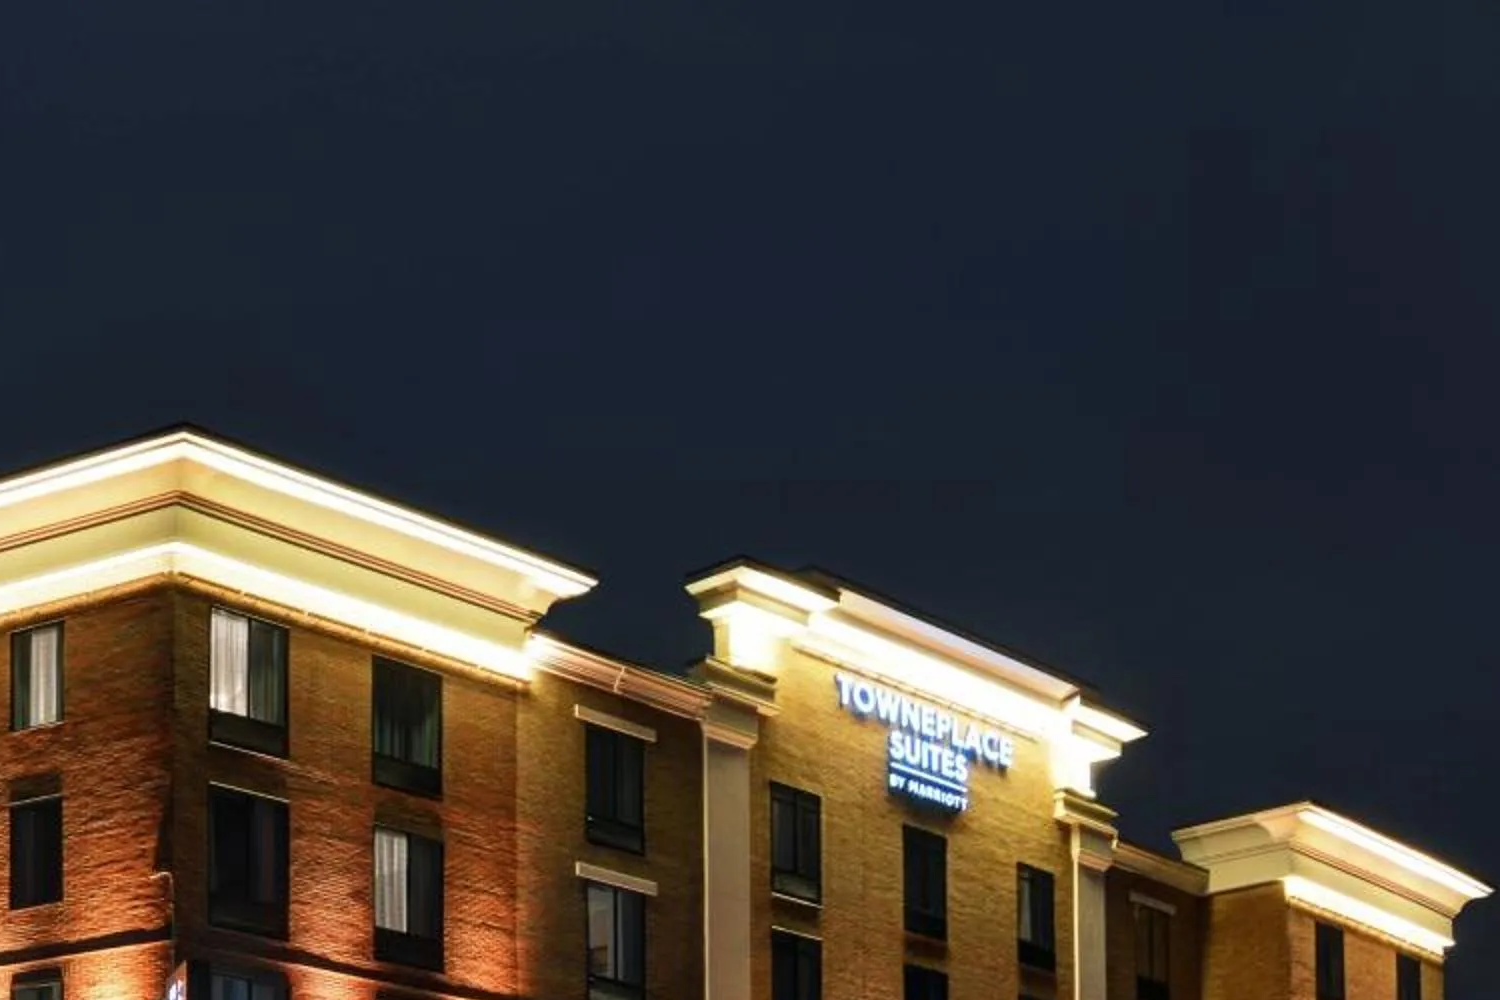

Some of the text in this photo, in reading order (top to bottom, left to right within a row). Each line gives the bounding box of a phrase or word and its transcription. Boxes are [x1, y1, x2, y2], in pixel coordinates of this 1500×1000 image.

[835, 673, 1014, 769] TOWNEPLACE
[888, 730, 969, 782] SUITES
[889, 774, 969, 811] BY MARRIOTT
